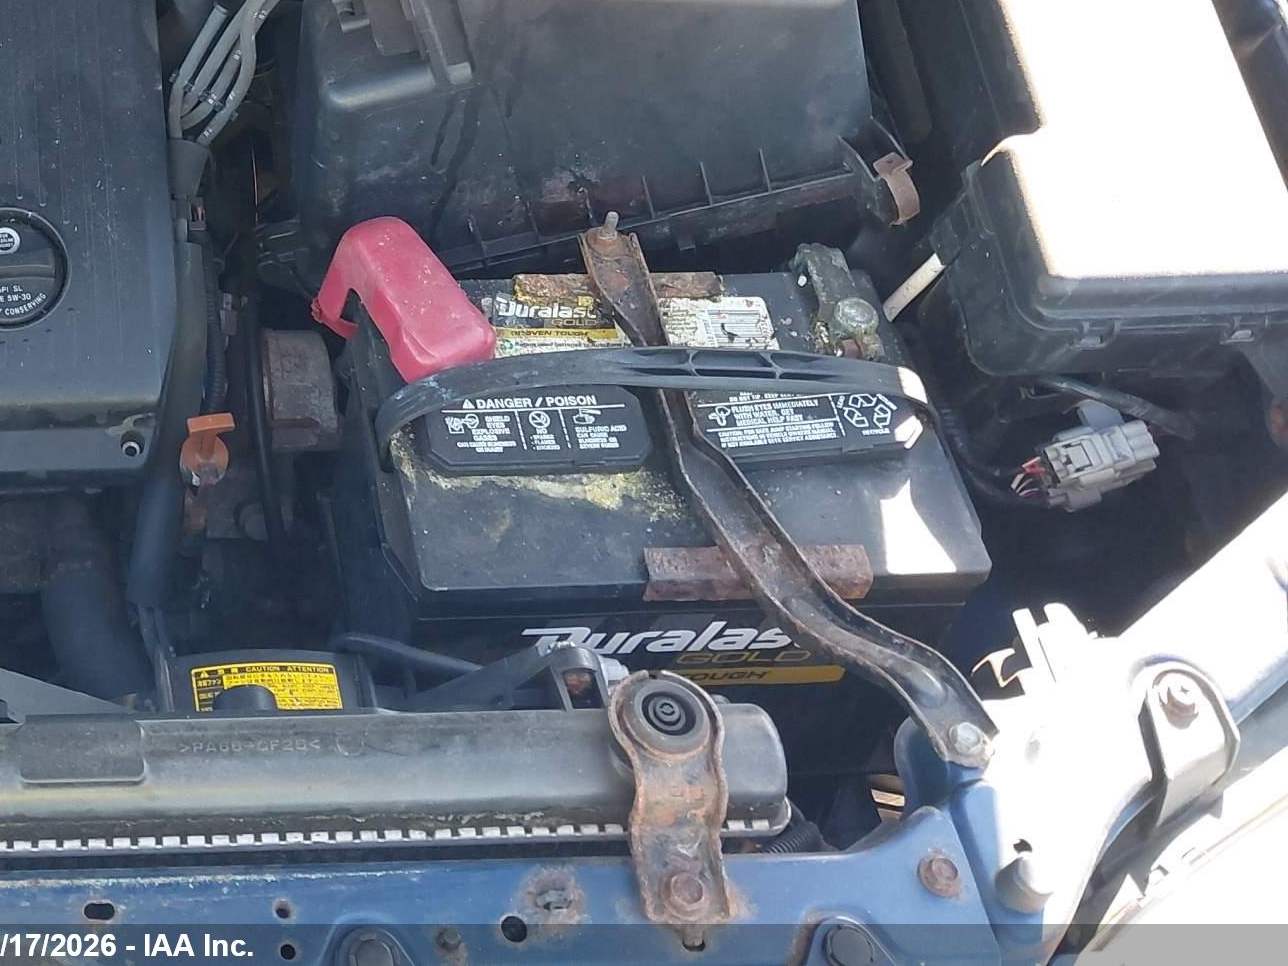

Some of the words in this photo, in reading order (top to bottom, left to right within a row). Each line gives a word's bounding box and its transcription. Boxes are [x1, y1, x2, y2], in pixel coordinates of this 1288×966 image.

[7, 293, 32, 302] 5W-30
[5, 292, 47, 316] CONSERVING
[552, 319, 598, 327] GOLD
[475, 397, 533, 410] DANGER
[545, 395, 597, 407] POISON
[754, 403, 773, 412] EYES
[767, 415, 786, 424] HELP
[786, 414, 804, 422] FAST
[610, 424, 628, 432] ACID
[521, 620, 801, 654] Duralas
[676, 650, 814, 665] GOLD
[245, 665, 280, 673] CAUTION
[287, 666, 329, 674] ATTENTION
